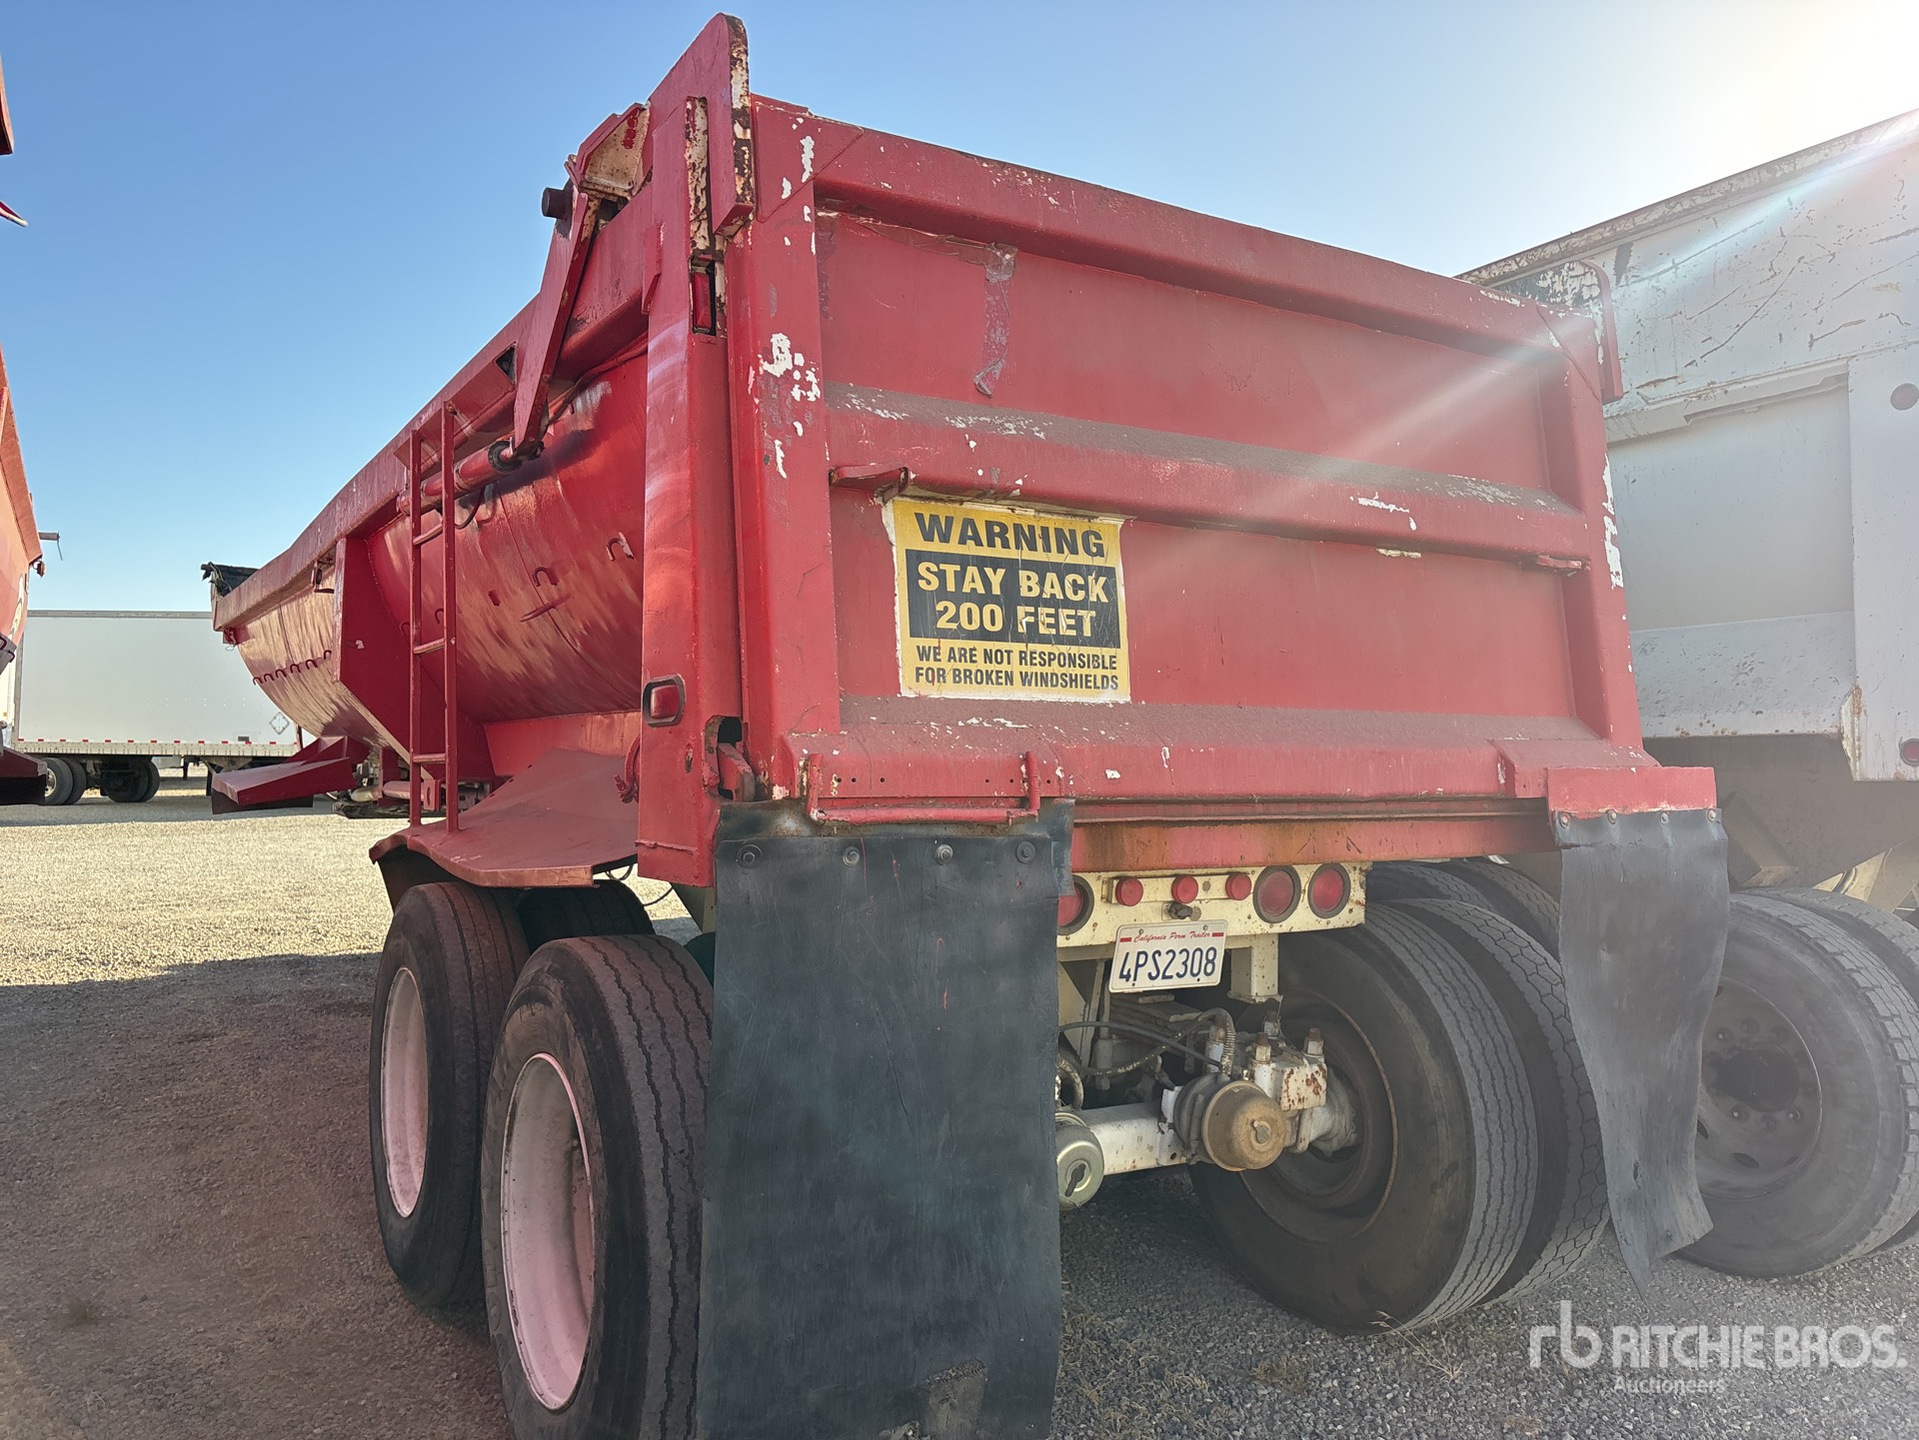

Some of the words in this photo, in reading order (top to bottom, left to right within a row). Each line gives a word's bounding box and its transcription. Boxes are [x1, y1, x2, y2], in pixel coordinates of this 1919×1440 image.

[914, 512, 1105, 558] WARNING
[917, 562, 1006, 595] STAY
[1019, 570, 1109, 603] BACK
[935, 601, 1004, 633] 200
[1017, 606, 1096, 637] FEET
[916, 645, 942, 663] WE
[947, 647, 978, 664] ARE
[983, 649, 1014, 665] NOT
[1019, 651, 1117, 670] RESPONSIBLE
[915, 667, 947, 684] FOR
[952, 669, 1014, 686] BROKEN
[1019, 671, 1119, 690] WINDSHIELDS
[1134, 933, 1167, 943] California
[1169, 932, 1186, 940] Perm
[1190, 930, 1210, 938] Trailer
[1119, 947, 1217, 982] 4PS2308
